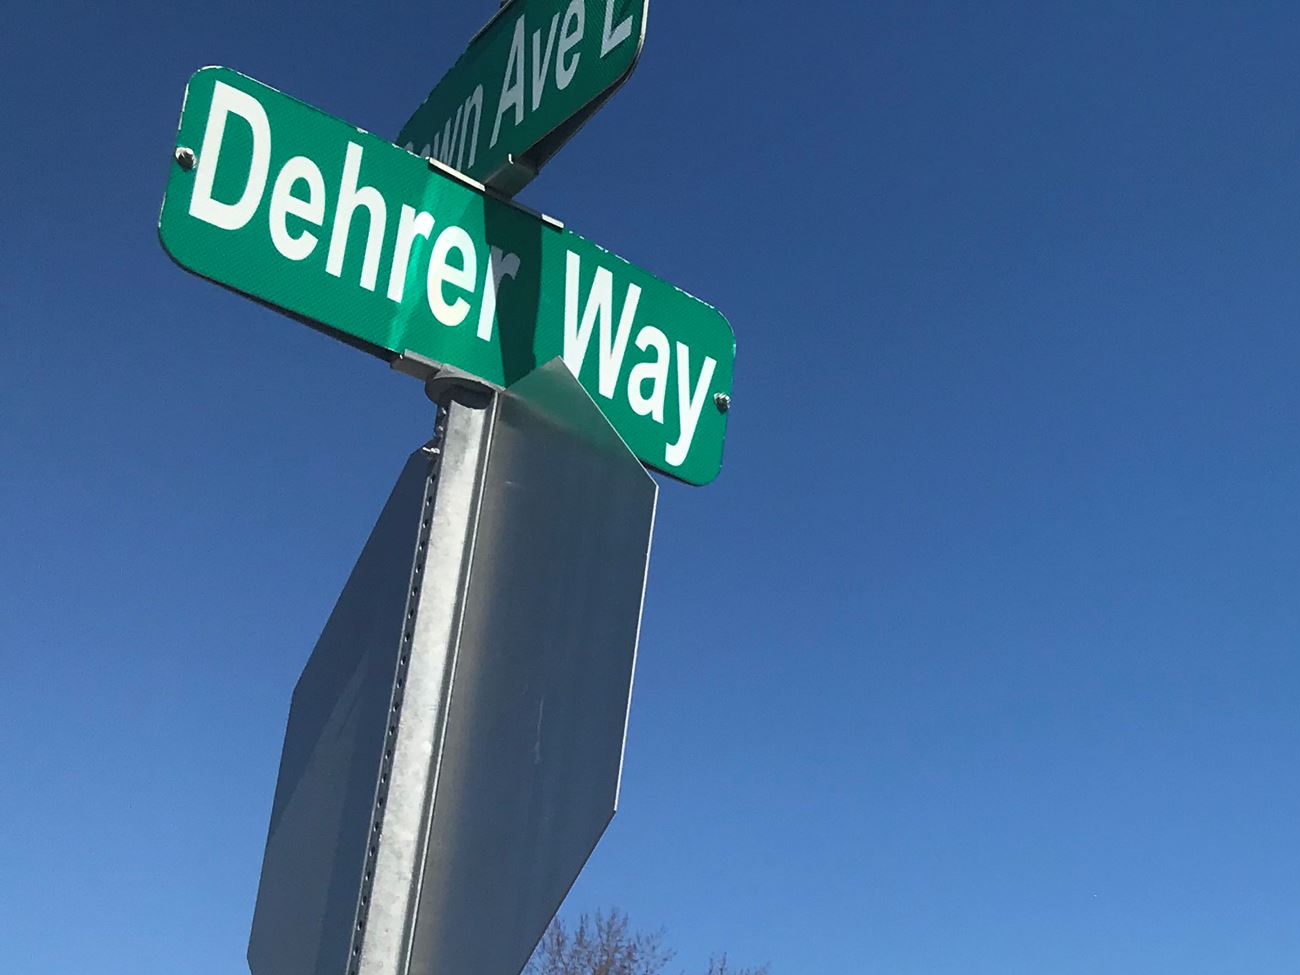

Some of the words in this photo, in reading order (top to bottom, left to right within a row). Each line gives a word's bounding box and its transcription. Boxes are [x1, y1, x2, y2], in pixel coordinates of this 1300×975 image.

[489, 0, 585, 149] Ave
[189, 80, 521, 342] Dehrer
[563, 249, 717, 467] Way
